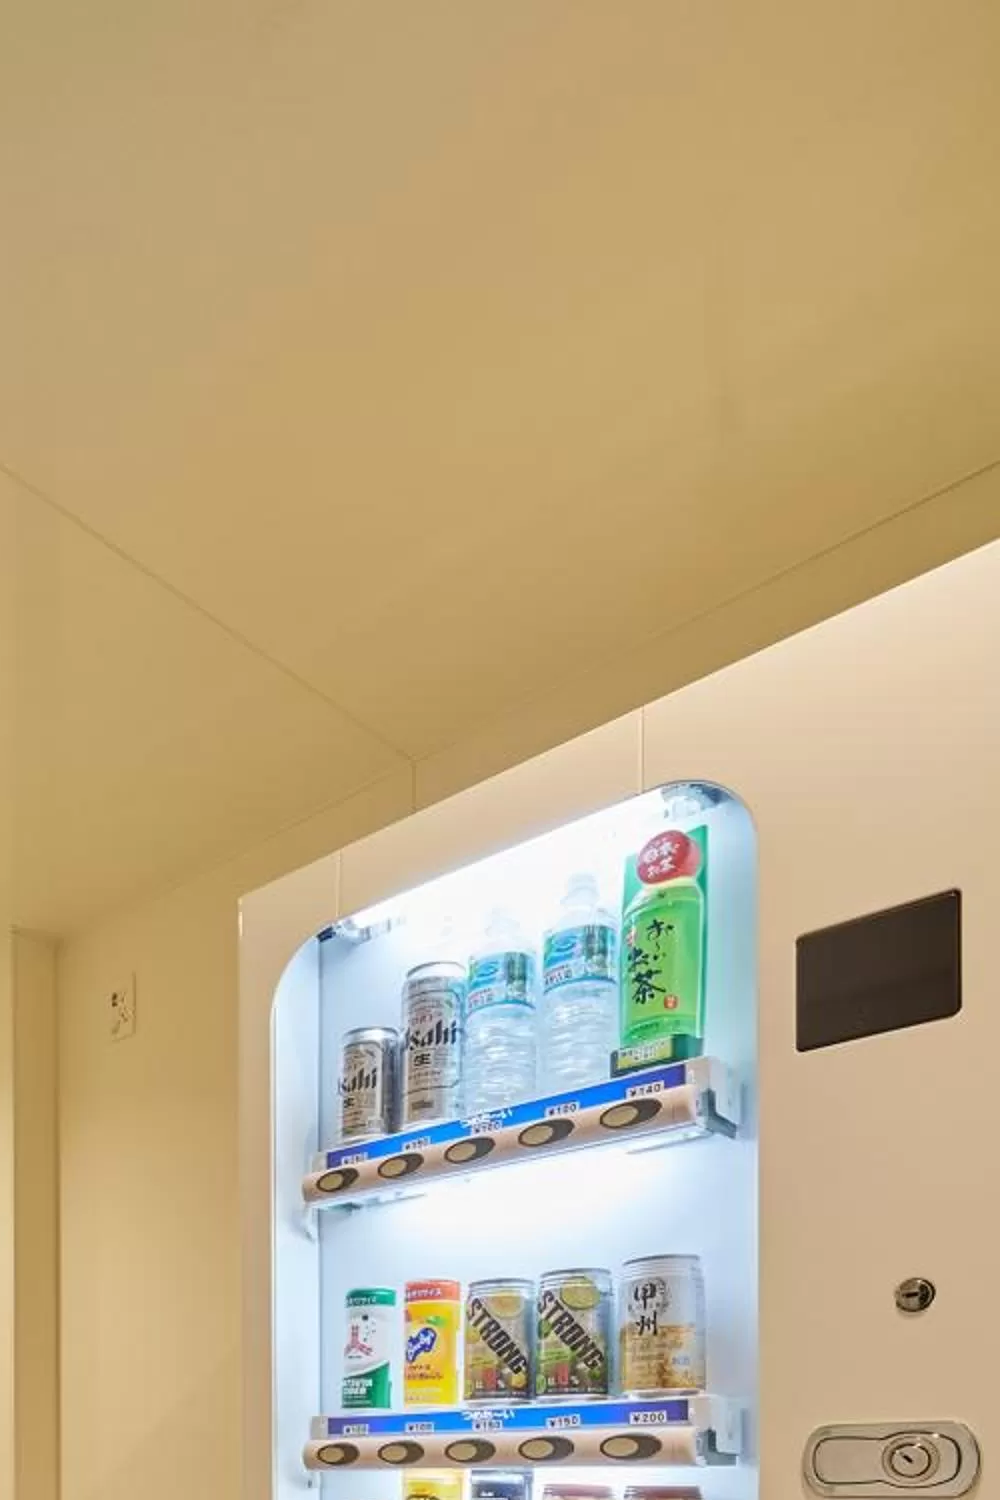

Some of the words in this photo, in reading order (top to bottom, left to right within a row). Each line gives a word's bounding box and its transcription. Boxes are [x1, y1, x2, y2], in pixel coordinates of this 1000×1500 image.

[338, 1067, 377, 1096] sahi
[629, 1083, 662, 1098] ¥140
[466, 1298, 528, 1374] STRONG
[537, 1290, 604, 1370] STRONG
[633, 1412, 666, 1423] ¥200
